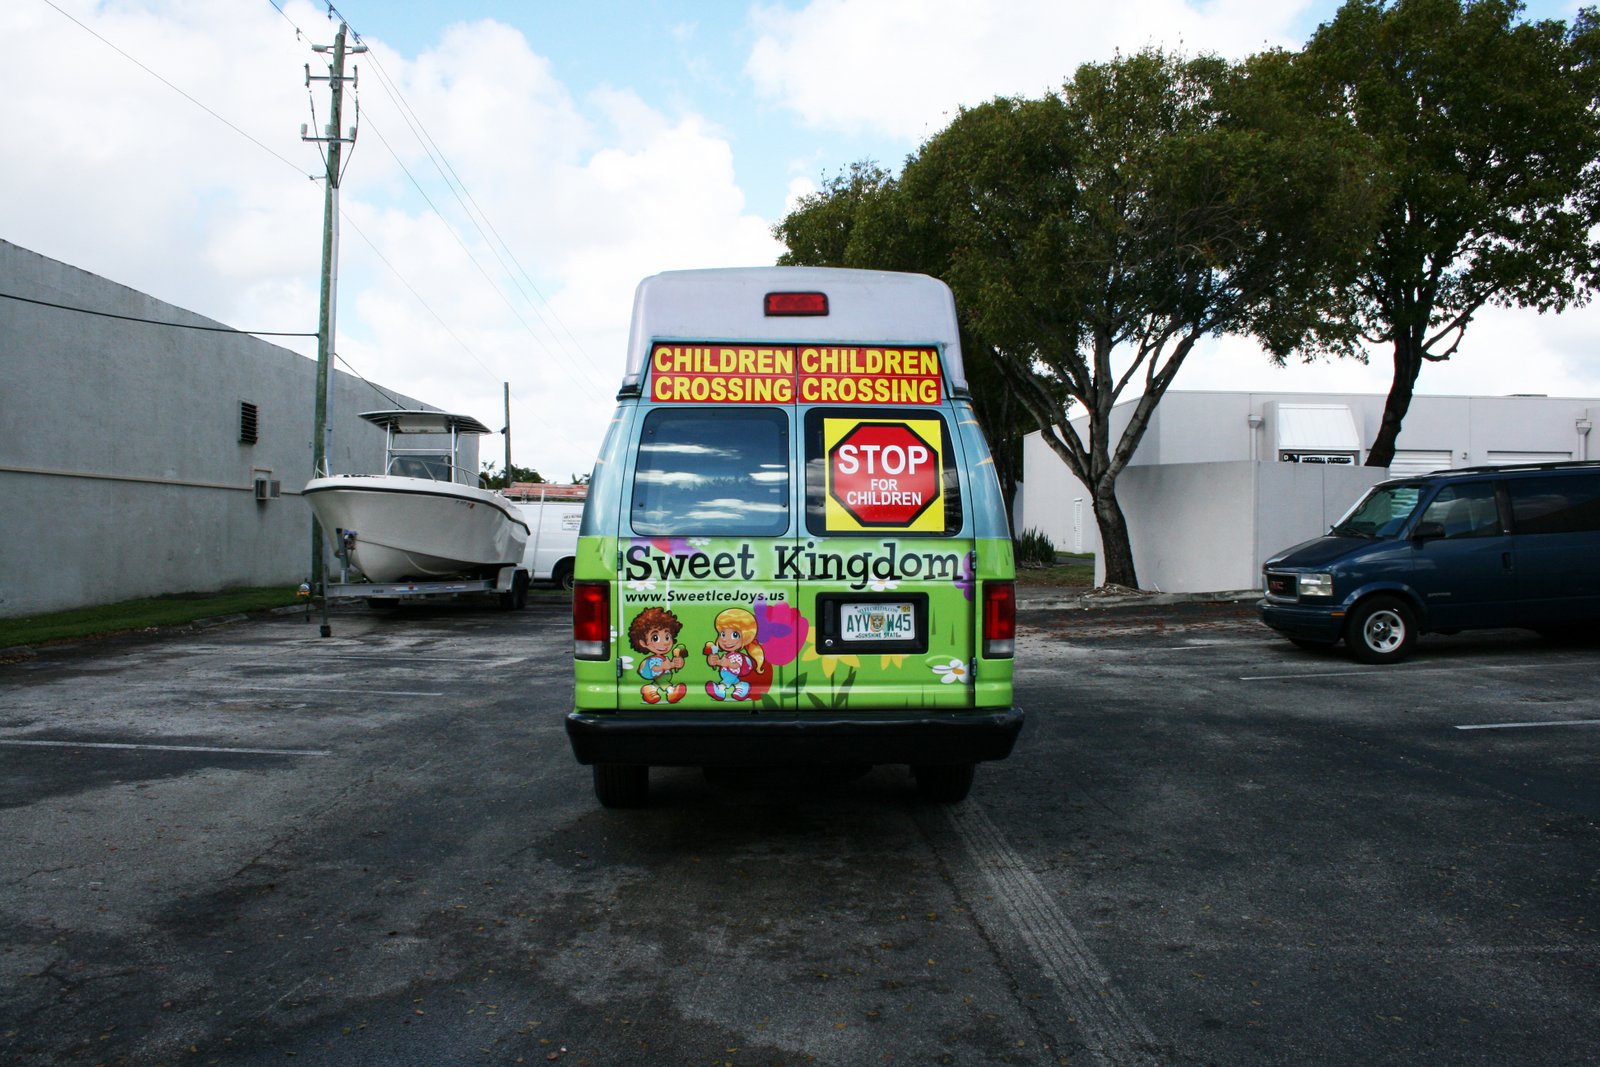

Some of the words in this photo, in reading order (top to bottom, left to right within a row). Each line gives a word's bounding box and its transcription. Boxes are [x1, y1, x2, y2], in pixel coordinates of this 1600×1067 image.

[654, 347, 794, 374] CHILDREN
[801, 348, 938, 375] CHILDREN
[654, 376, 792, 402] CROSSING
[802, 377, 938, 403] CROSSING
[838, 444, 929, 475] STOP
[870, 479, 898, 491] FOR
[846, 491, 922, 506] CHILDREN
[625, 543, 755, 581] Sweet
[774, 541, 964, 590] Kingdom
[625, 590, 785, 604] www.SweetIceJoys.us
[846, 614, 871, 632] AYV
[886, 613, 911, 632] W45
